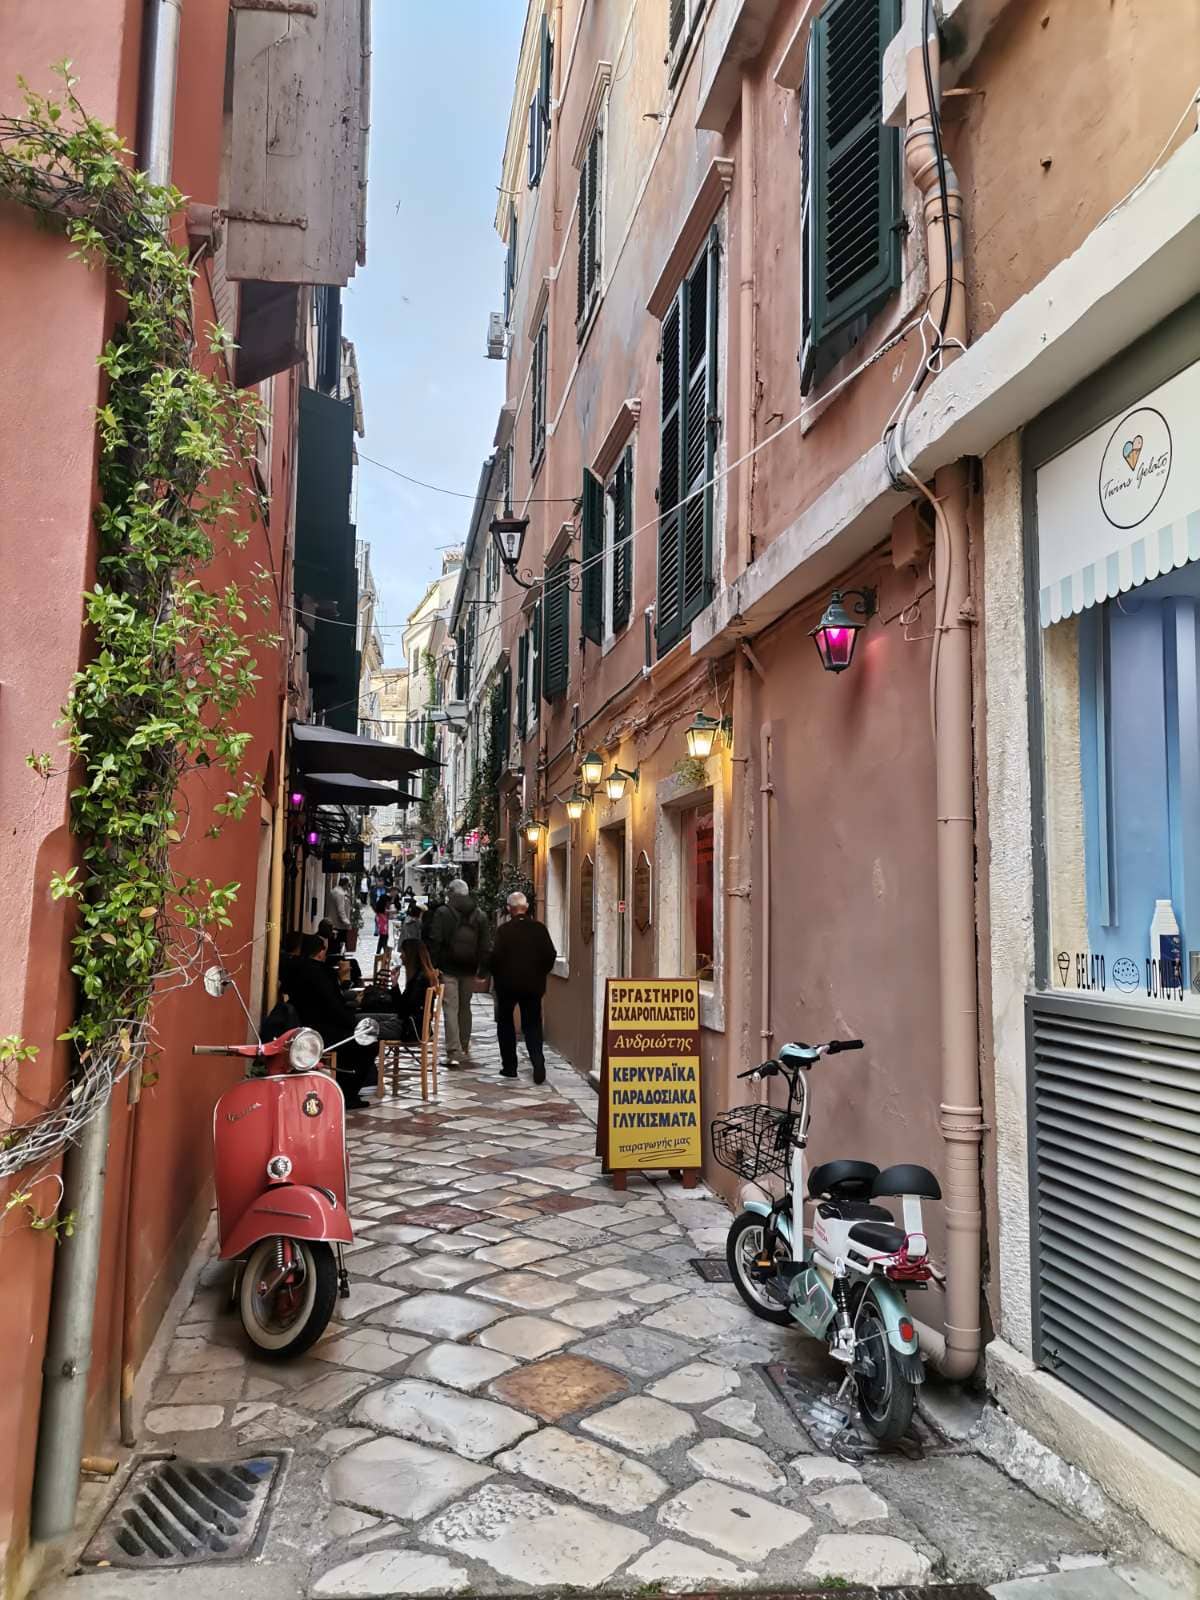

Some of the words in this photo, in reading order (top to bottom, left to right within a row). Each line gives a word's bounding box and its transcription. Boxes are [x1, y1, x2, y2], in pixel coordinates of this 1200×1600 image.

[1136, 452, 1168, 489] Gelato
[1075, 953, 1106, 992] GELATO
[611, 988, 695, 1003] ΕΡΓΑΣΤΗΡΙΟ
[611, 1006, 695, 1022] ΖΑΧΑΡΟΠΛΑΣΤΕΙΟ
[614, 1034, 693, 1052] Ανδριώτης
[612, 1063, 695, 1082] ΚΕΡΚΥΡΑΪΚΑ
[612, 1089, 696, 1105] ΠΑΡΑΔΟΣΙΑΚΑ
[612, 1112, 697, 1128] ΓΛΥΚΙΣΜΑΤΑ
[619, 1138, 672, 1153] παραγωγής
[673, 1137, 691, 1149] μας
